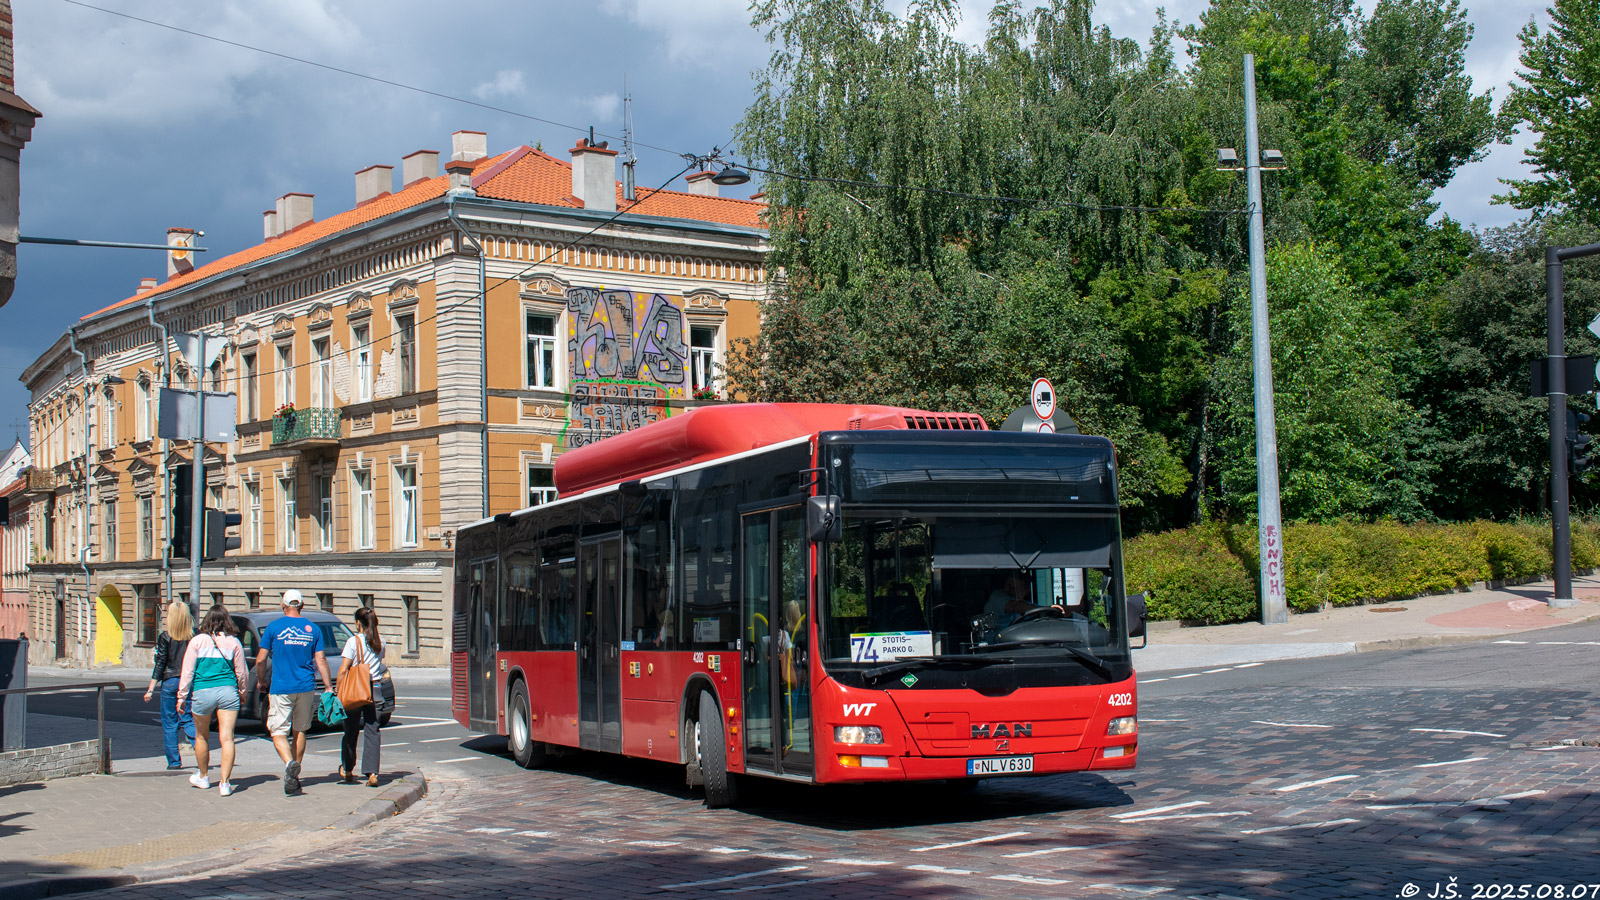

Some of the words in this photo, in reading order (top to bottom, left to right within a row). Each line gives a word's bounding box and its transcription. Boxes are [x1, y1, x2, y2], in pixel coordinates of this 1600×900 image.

[851, 637, 879, 662] 74
[1108, 692, 1132, 706] 4202
[971, 722, 1032, 738] MAN
